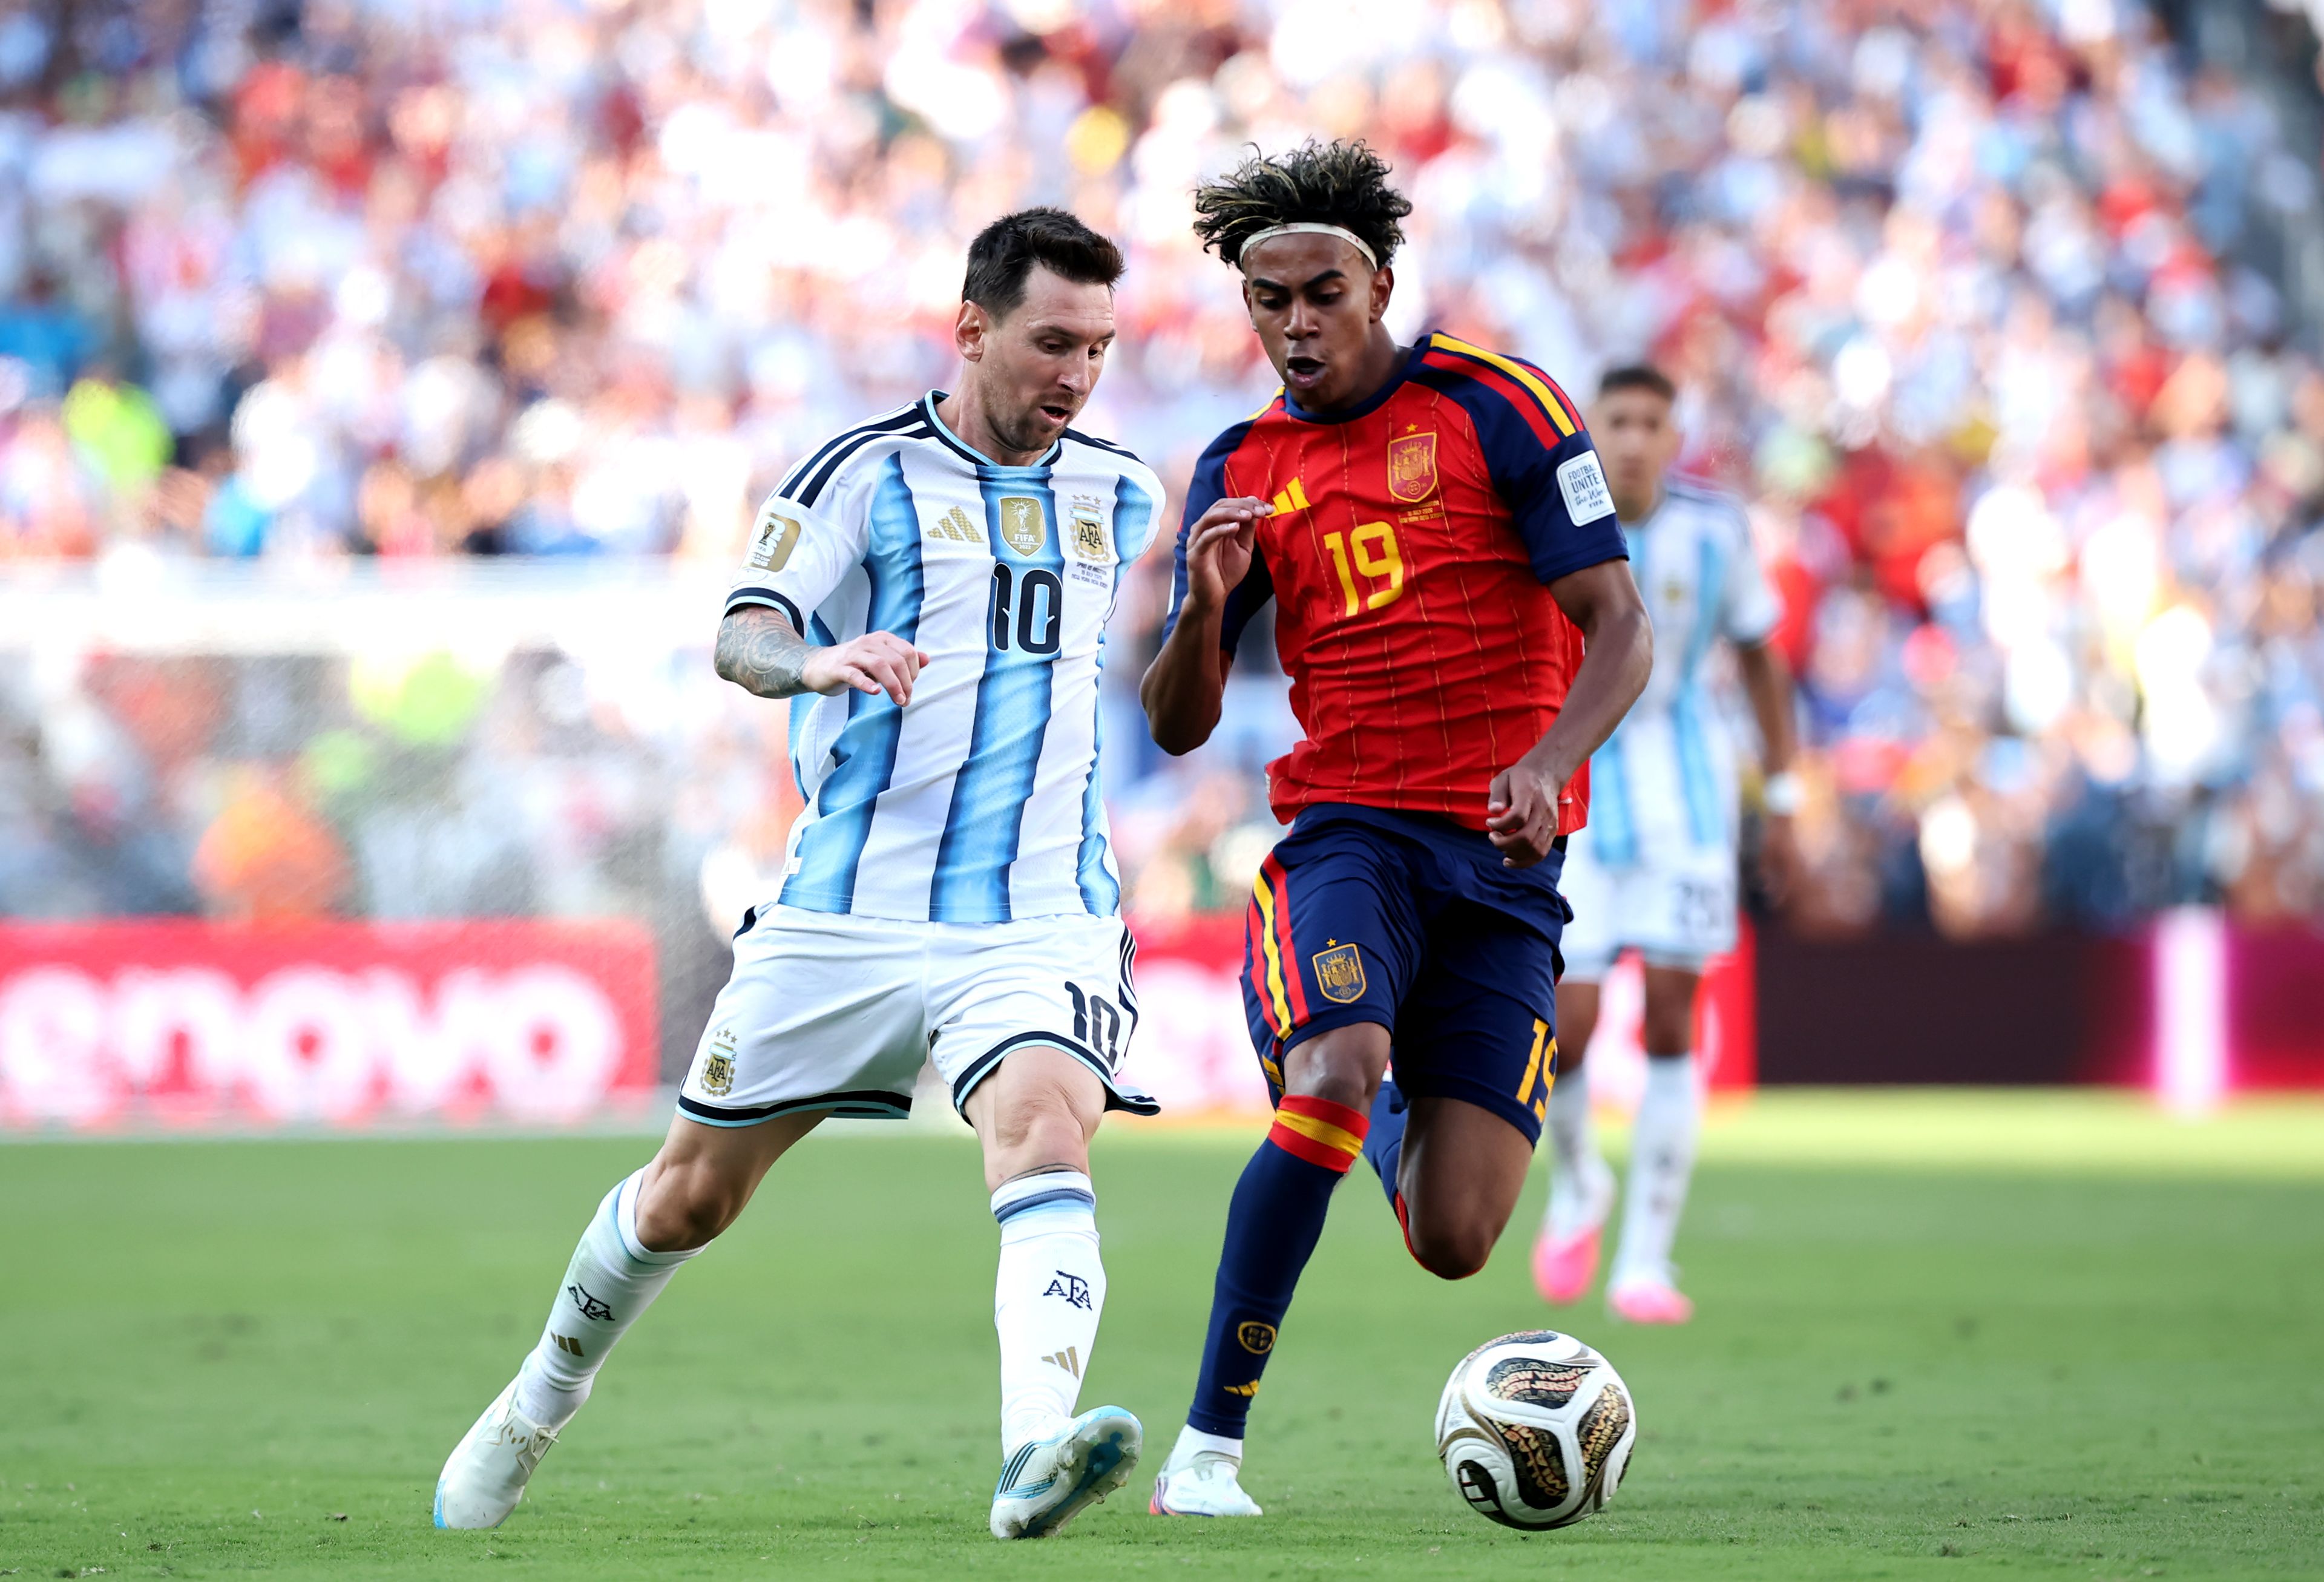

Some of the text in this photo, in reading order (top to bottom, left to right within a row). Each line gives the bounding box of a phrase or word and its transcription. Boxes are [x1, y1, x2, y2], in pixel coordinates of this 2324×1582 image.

[1014, 534, 1035, 542] FIFA
[1080, 520, 1102, 548] AFA
[1324, 521, 1403, 617] 19
[993, 562, 1063, 654] 10
[1065, 981, 1120, 1071] 10
[707, 1055, 726, 1081] AFA
[1516, 1018, 1558, 1123] 19
[1043, 1270, 1092, 1311] AFA
